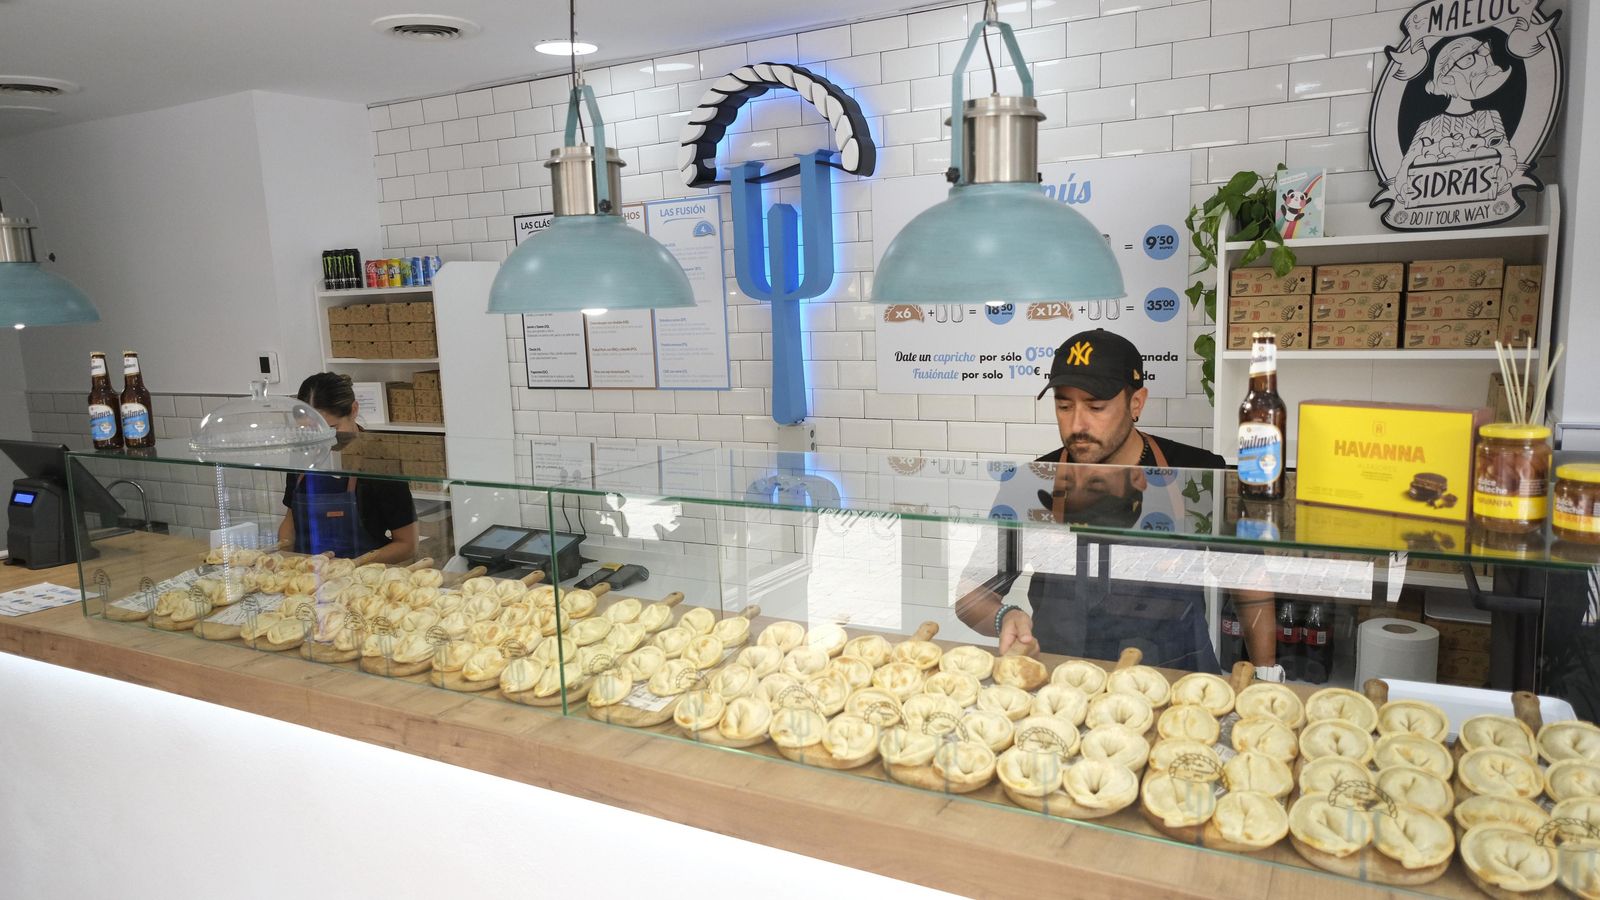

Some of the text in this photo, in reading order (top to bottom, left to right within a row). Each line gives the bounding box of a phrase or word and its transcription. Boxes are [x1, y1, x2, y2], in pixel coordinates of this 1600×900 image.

[1040, 172, 1092, 205] nús
[1410, 165, 1494, 200] SIDRAS
[660, 204, 706, 217] LAS FUSIÓN
[1409, 211, 1424, 226] DO
[1436, 209, 1461, 225] YOUR
[1464, 204, 1490, 222] WAY
[520, 218, 551, 230] LAS CLÁS
[1036, 303, 1061, 317] x12
[894, 351, 917, 362] Date
[918, 353, 932, 362] un
[933, 352, 976, 366] capricho
[979, 354, 998, 364] por
[1000, 352, 1022, 362] sólo
[912, 368, 960, 379] Fusiónate
[961, 371, 980, 381] por
[982, 370, 1004, 379] solo
[1333, 439, 1426, 464] HAVANNA
